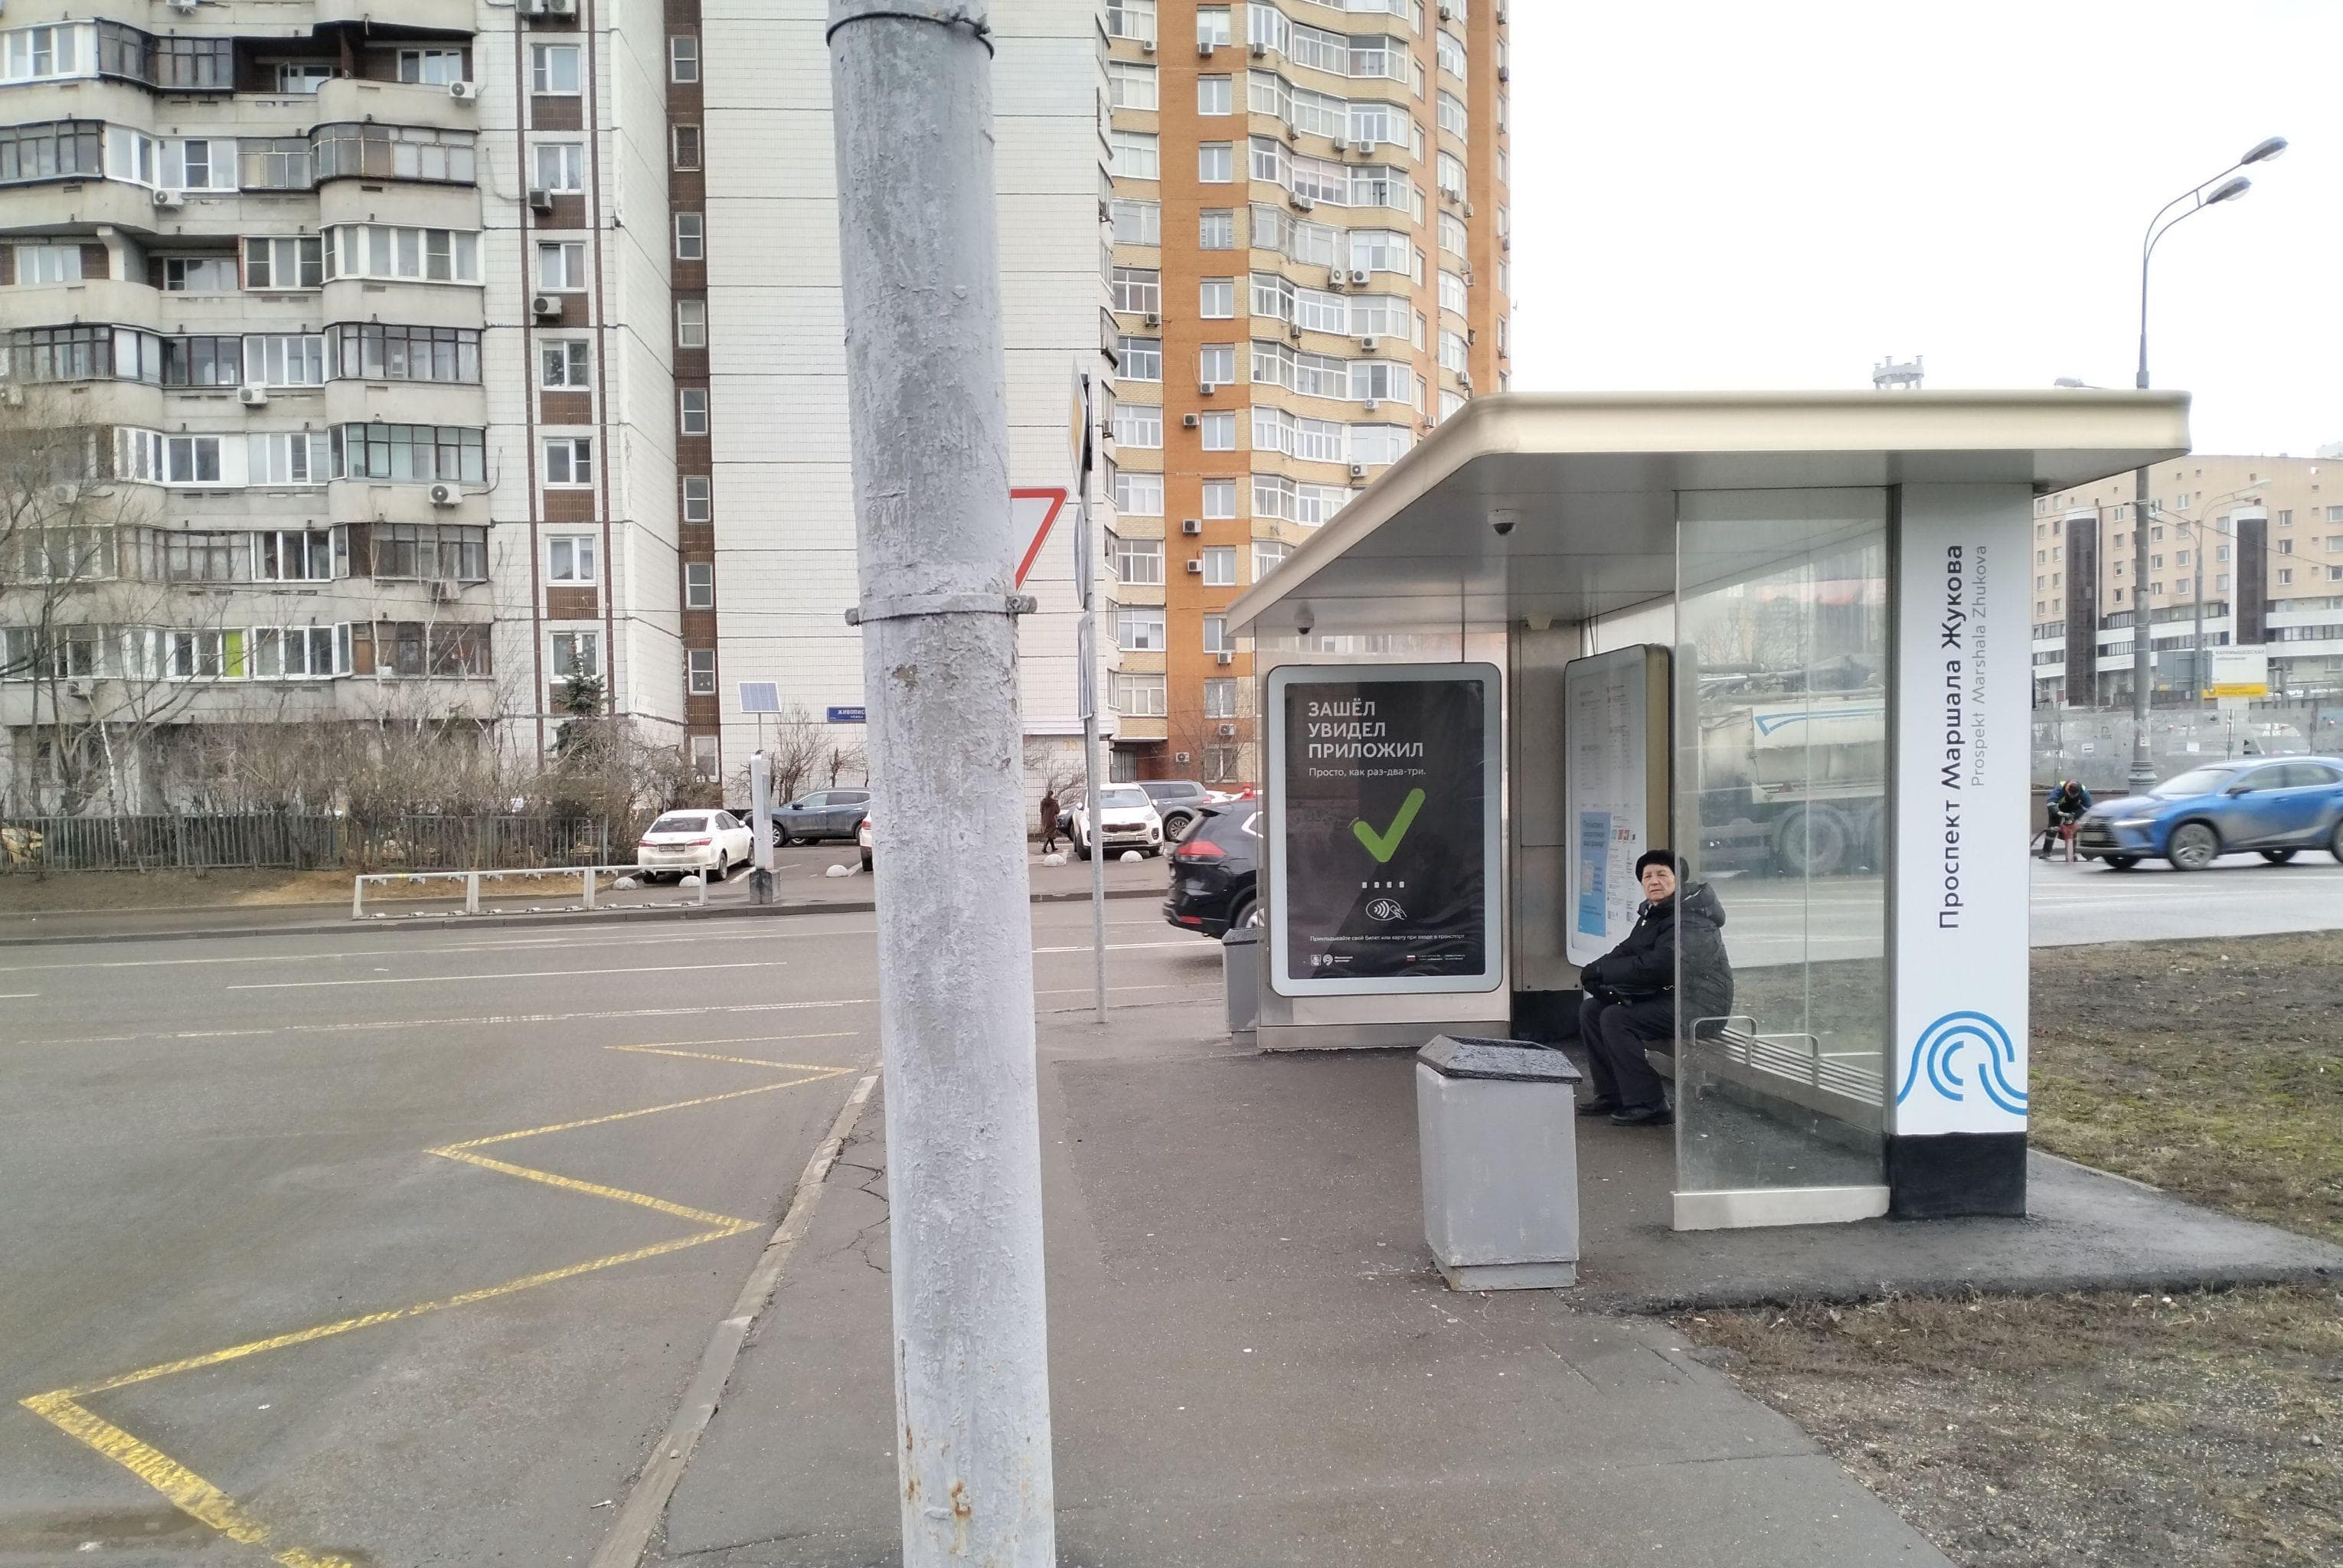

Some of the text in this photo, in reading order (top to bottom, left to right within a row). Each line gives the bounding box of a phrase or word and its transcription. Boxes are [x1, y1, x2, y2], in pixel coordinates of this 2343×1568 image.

[1971, 545, 1988, 786] Prospekt Marshala Zhukova
[1308, 697, 1375, 717] ЗАШЁЛ
[1308, 722, 1386, 740] УВИДЕЛ
[1939, 545, 1967, 929] Проспект Маршала Жукова
[1309, 742, 1423, 759] ПРИЛОЖИЛ
[1309, 767, 1347, 778] Просто,
[1367, 768, 1426, 778] раз-два-три.
